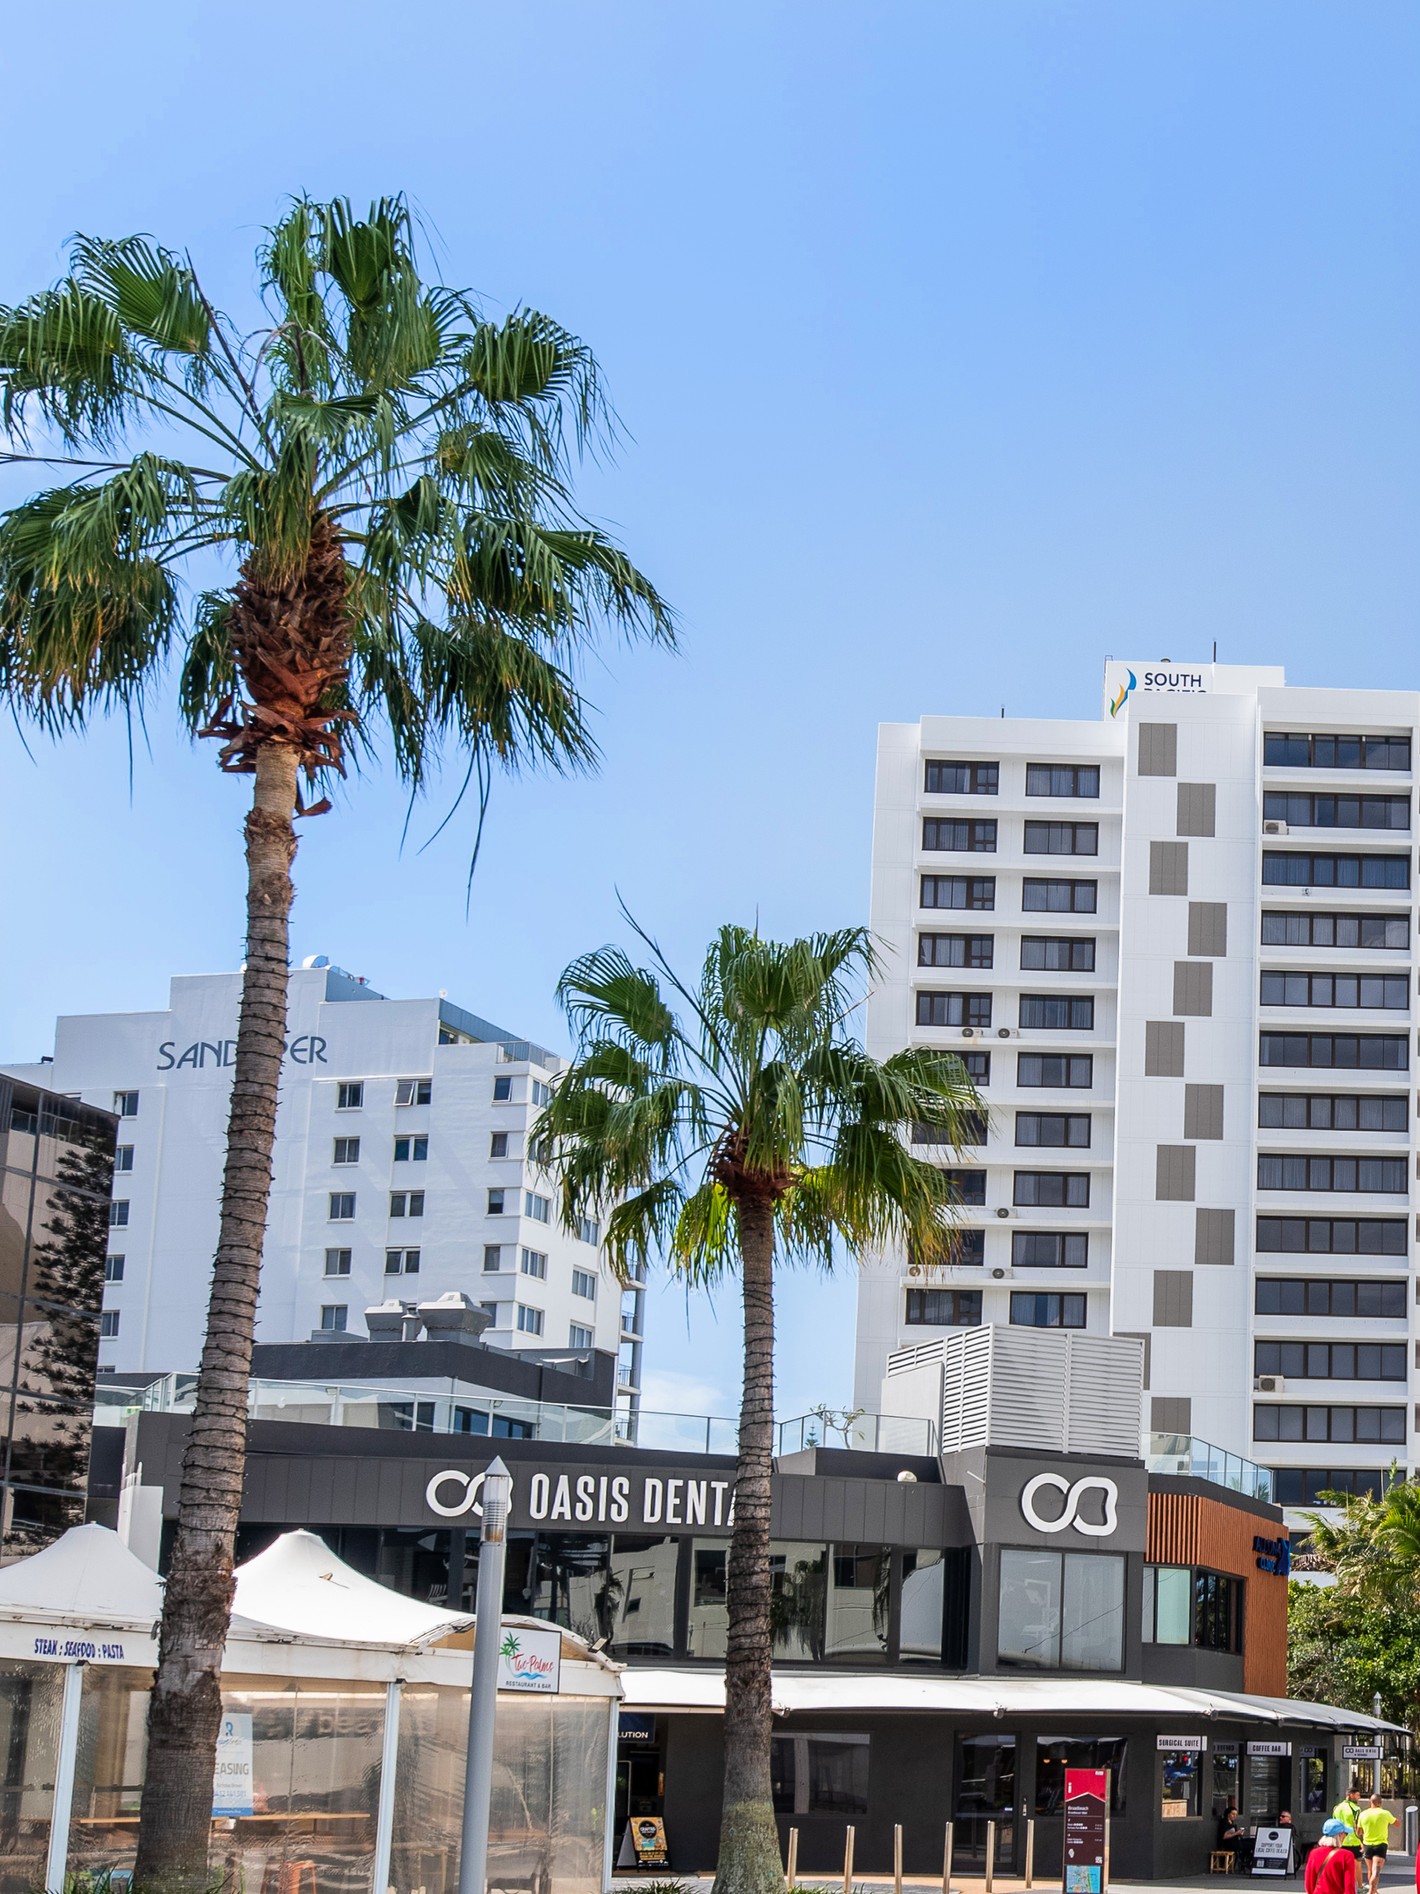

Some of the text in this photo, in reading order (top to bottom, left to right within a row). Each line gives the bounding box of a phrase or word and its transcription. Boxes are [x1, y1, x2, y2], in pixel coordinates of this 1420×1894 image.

[1143, 672, 1202, 688] SOUTH
[156, 1035, 328, 1071] SANDER
[529, 1473, 737, 1527] OASIS DENT
[34, 1638, 58, 1655] STEAK
[64, 1641, 96, 1658] SEAFOOD
[102, 1644, 125, 1660] PASTA
[505, 1680, 537, 1688] RESTAURANT
[617, 1731, 649, 1739] LUTION
[1158, 1739, 1199, 1748] SURGICAL SUITE
[1252, 1744, 1270, 1752] COFFEE
[215, 1762, 250, 1776] EASING
